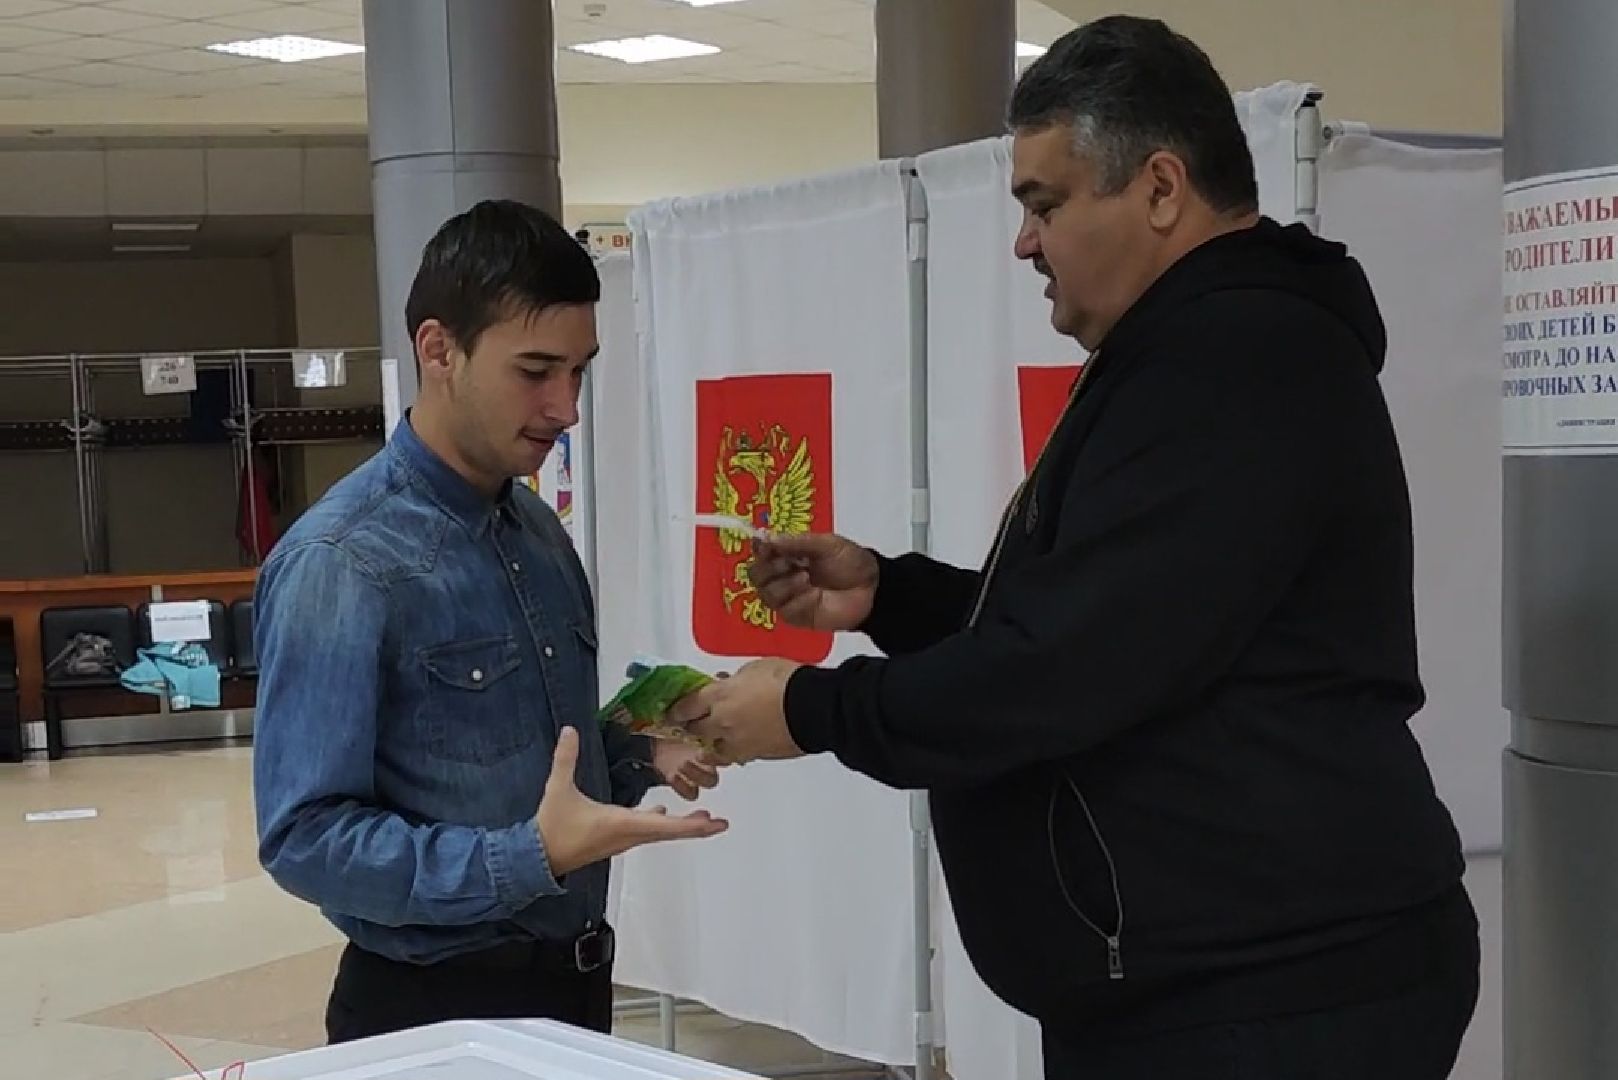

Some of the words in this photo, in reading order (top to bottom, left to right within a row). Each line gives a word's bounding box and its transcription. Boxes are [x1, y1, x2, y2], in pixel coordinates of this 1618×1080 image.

[1505, 236, 1613, 272] РОДИТЕЛИ
[1538, 311, 1595, 340] ДЕТЕЙ
[1555, 346, 1580, 368] ДО
[1592, 374, 1617, 394] ЗА
